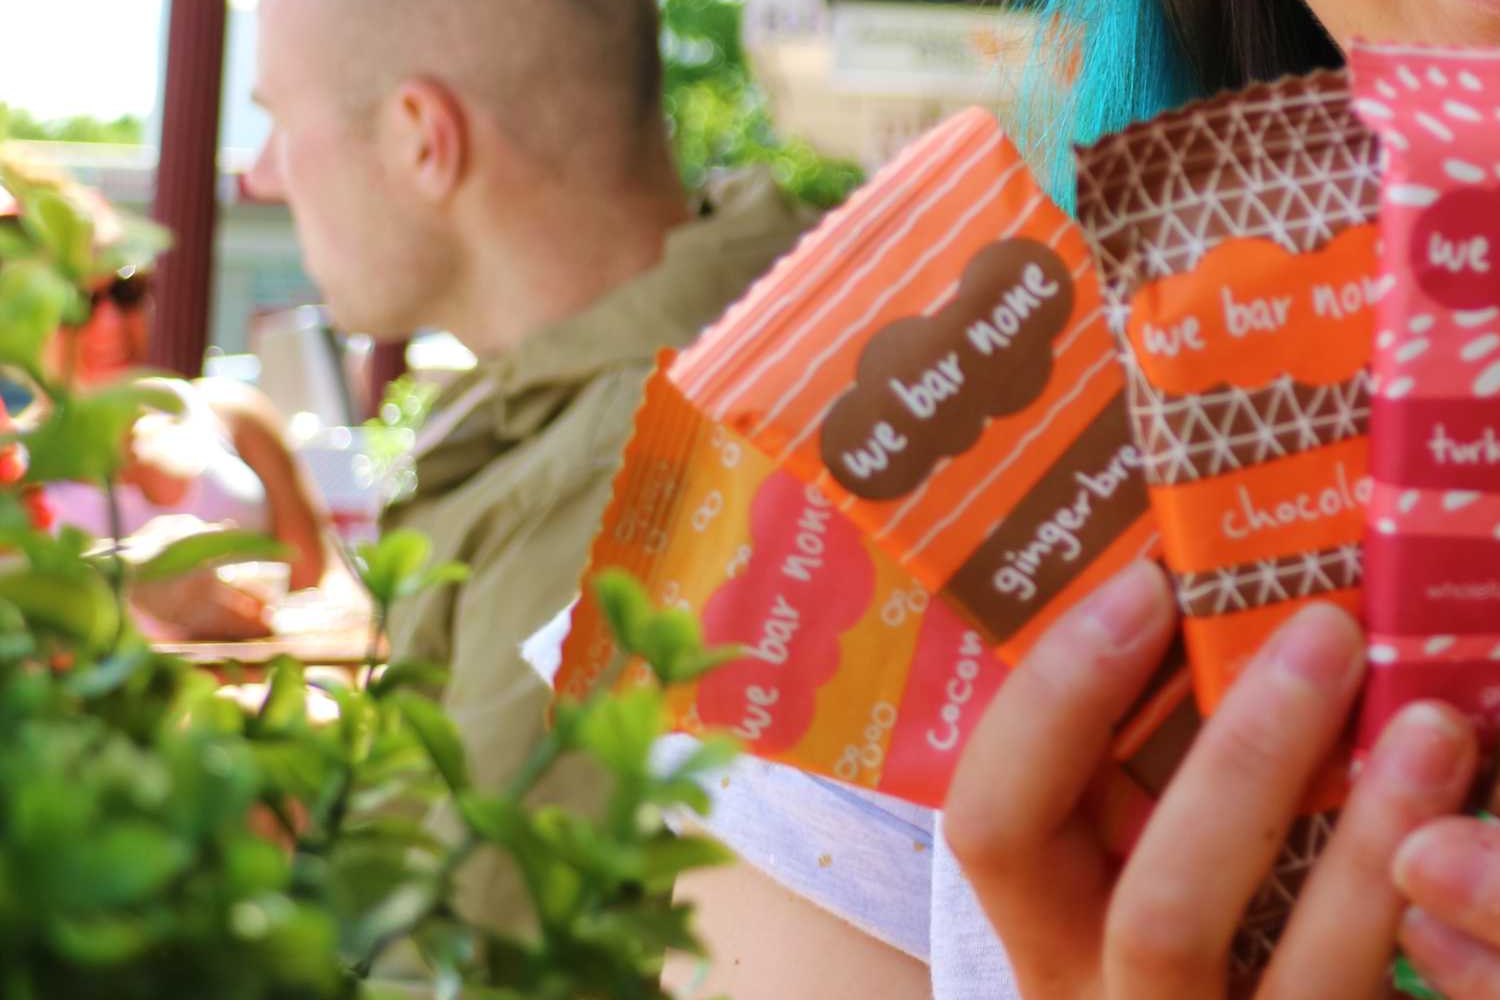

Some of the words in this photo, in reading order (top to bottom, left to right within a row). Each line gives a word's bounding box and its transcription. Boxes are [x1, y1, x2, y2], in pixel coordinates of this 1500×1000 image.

[1429, 231, 1491, 273] we
[1142, 317, 1206, 357] we
[1220, 286, 1292, 338] bar
[843, 421, 908, 478] we
[889, 352, 965, 419] bar
[966, 262, 1060, 356] none
[781, 482, 832, 582] none
[740, 592, 800, 666] bar
[733, 684, 780, 741] we
